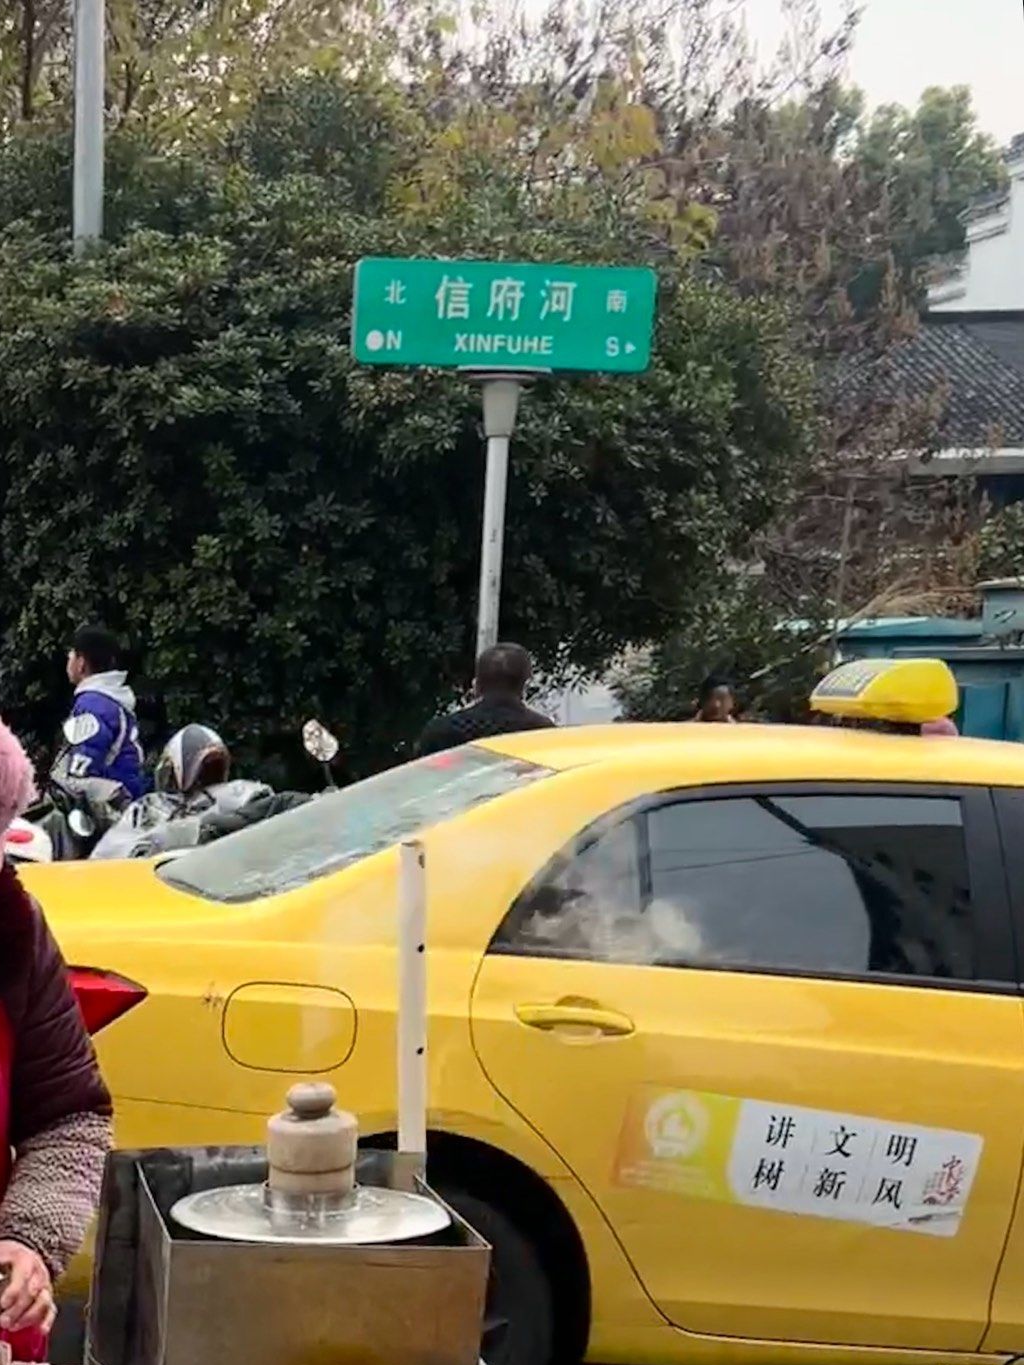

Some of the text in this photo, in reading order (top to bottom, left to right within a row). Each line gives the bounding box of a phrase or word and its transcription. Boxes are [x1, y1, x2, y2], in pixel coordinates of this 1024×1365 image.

[385, 279, 406, 304] 北
[435, 275, 576, 322] 信府河
[606, 289, 627, 313] 南
[385, 330, 402, 350] N
[454, 333, 553, 355] XINFUHE
[605, 336, 619, 356] S
[765, 1114, 918, 1167] 讲文明
[753, 1157, 903, 1209] 树新风
